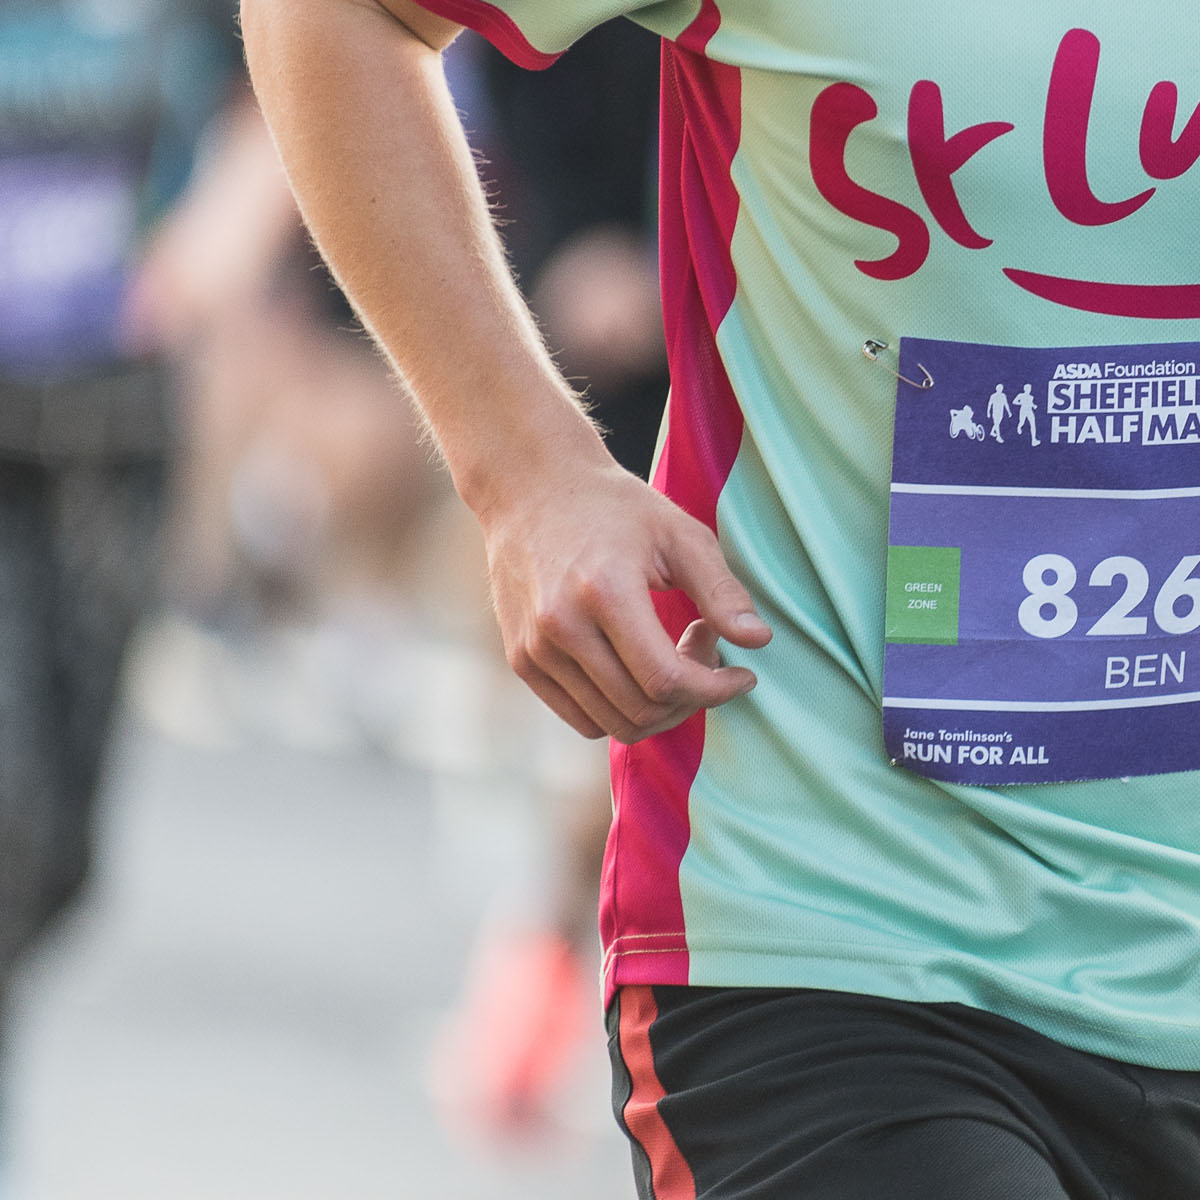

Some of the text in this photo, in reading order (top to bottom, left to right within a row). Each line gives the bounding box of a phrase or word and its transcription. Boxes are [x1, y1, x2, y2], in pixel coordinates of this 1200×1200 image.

[809, 79, 1015, 281] St
[1052, 360, 1196, 379] ASDA Foundation
[1050, 414, 1140, 444] HALF
[904, 582, 943, 593] GREEN
[907, 599, 938, 610] ZONE
[1104, 650, 1187, 689] BEN
[903, 728, 1013, 743] Jane Tomlinson's
[903, 742, 1050, 766] RUN FOR ALL
